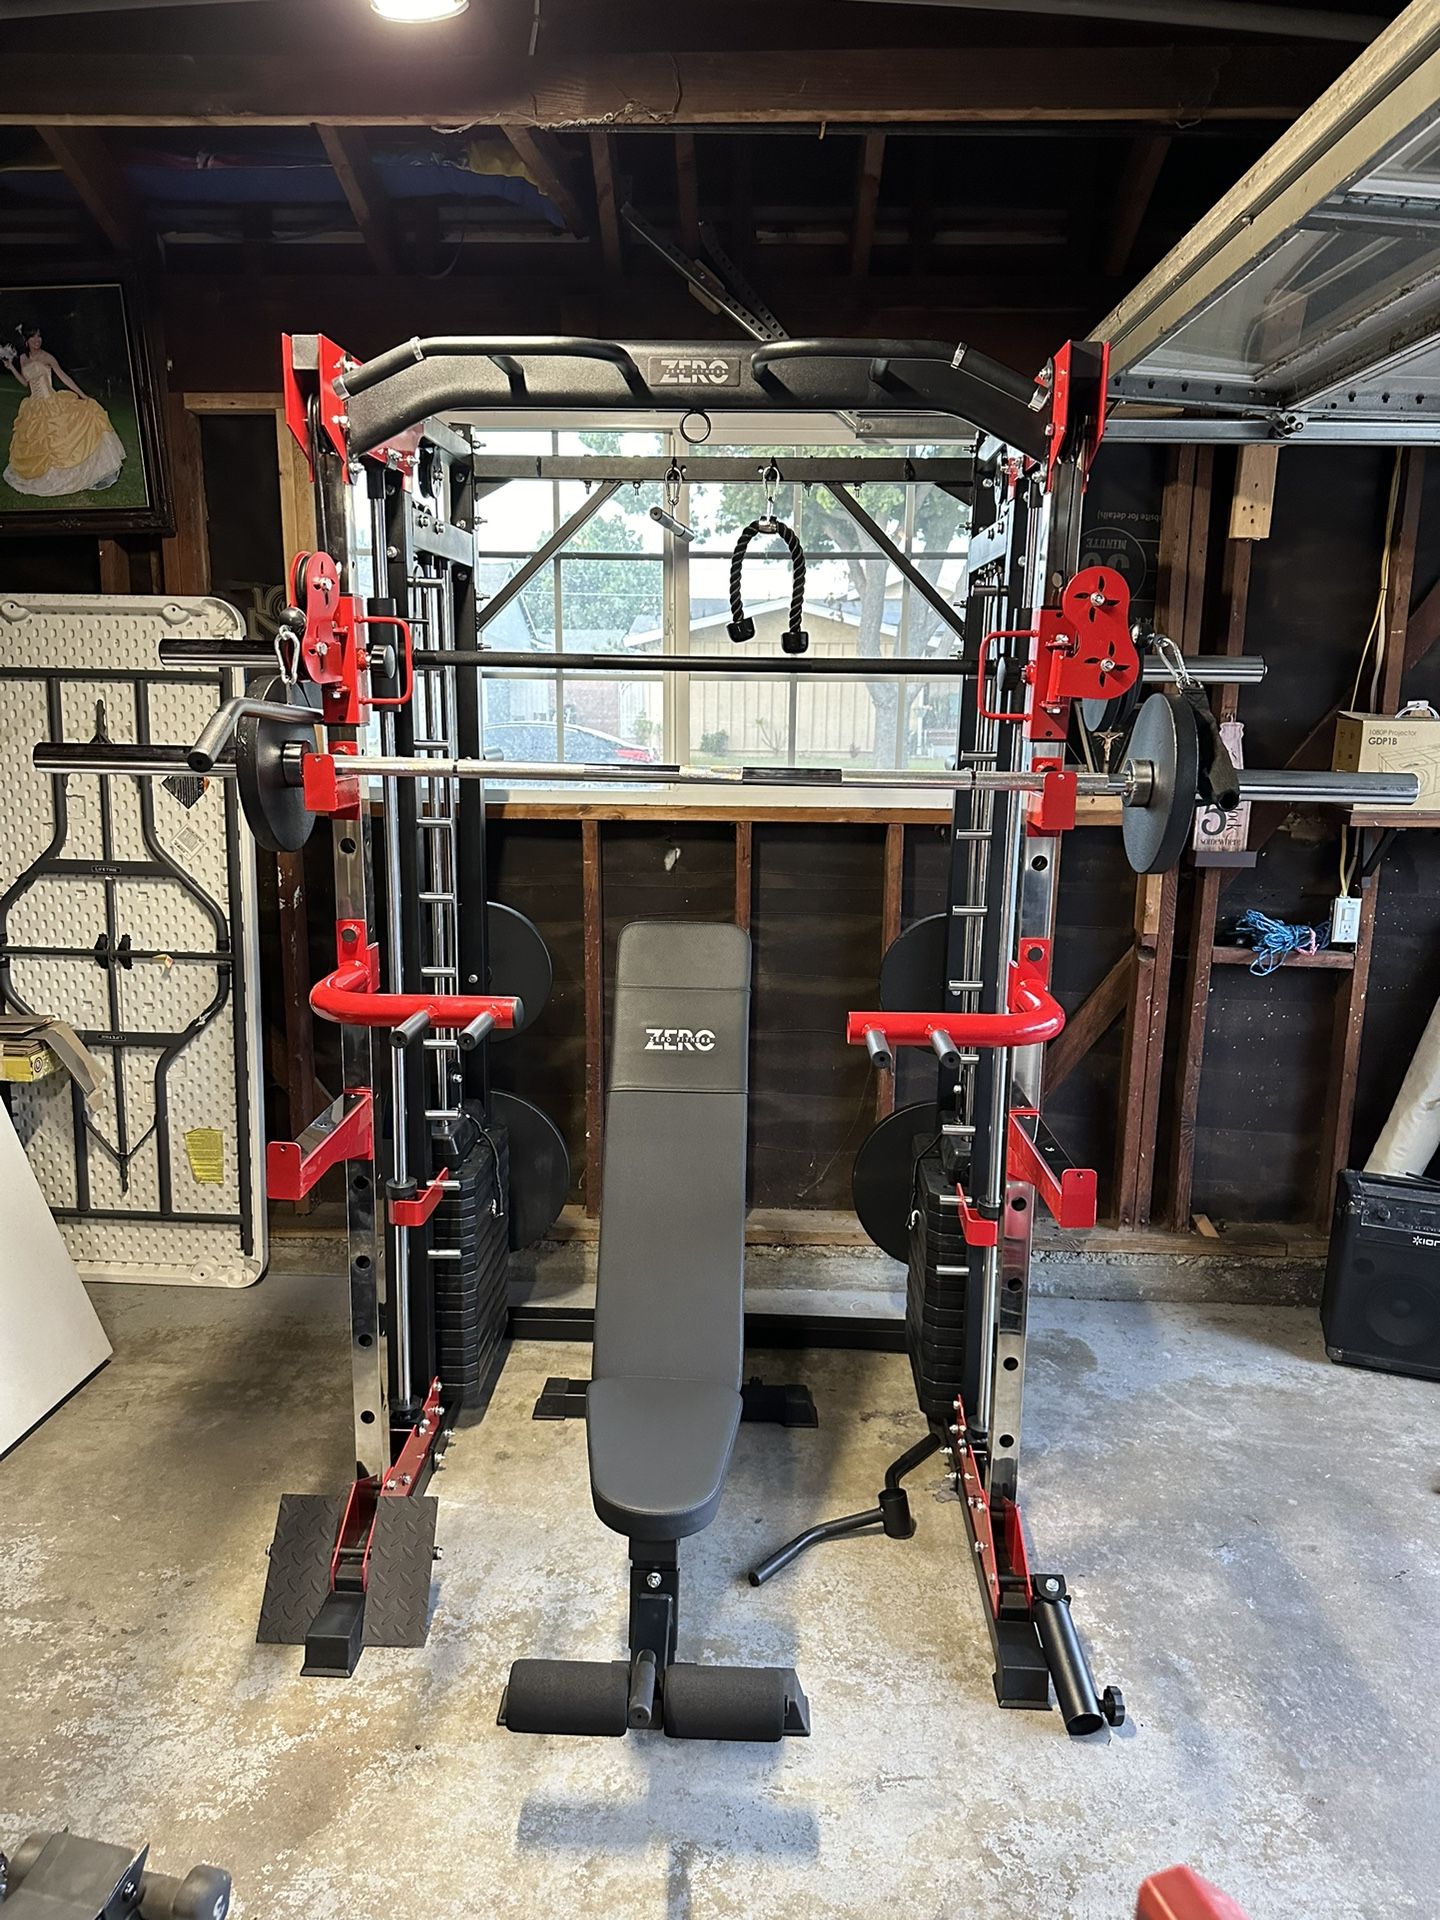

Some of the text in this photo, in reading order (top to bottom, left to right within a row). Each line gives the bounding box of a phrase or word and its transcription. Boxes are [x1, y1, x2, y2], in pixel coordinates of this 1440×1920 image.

[660, 360, 729, 384] ZERO
[1127, 513, 1139, 522] for
[1140, 514, 1160, 522] bsite
[1085, 538, 1128, 550] MINUTE
[1368, 737, 1398, 745] GDP1B
[1200, 804, 1227, 836] 5
[644, 1028, 716, 1051] ZERO
